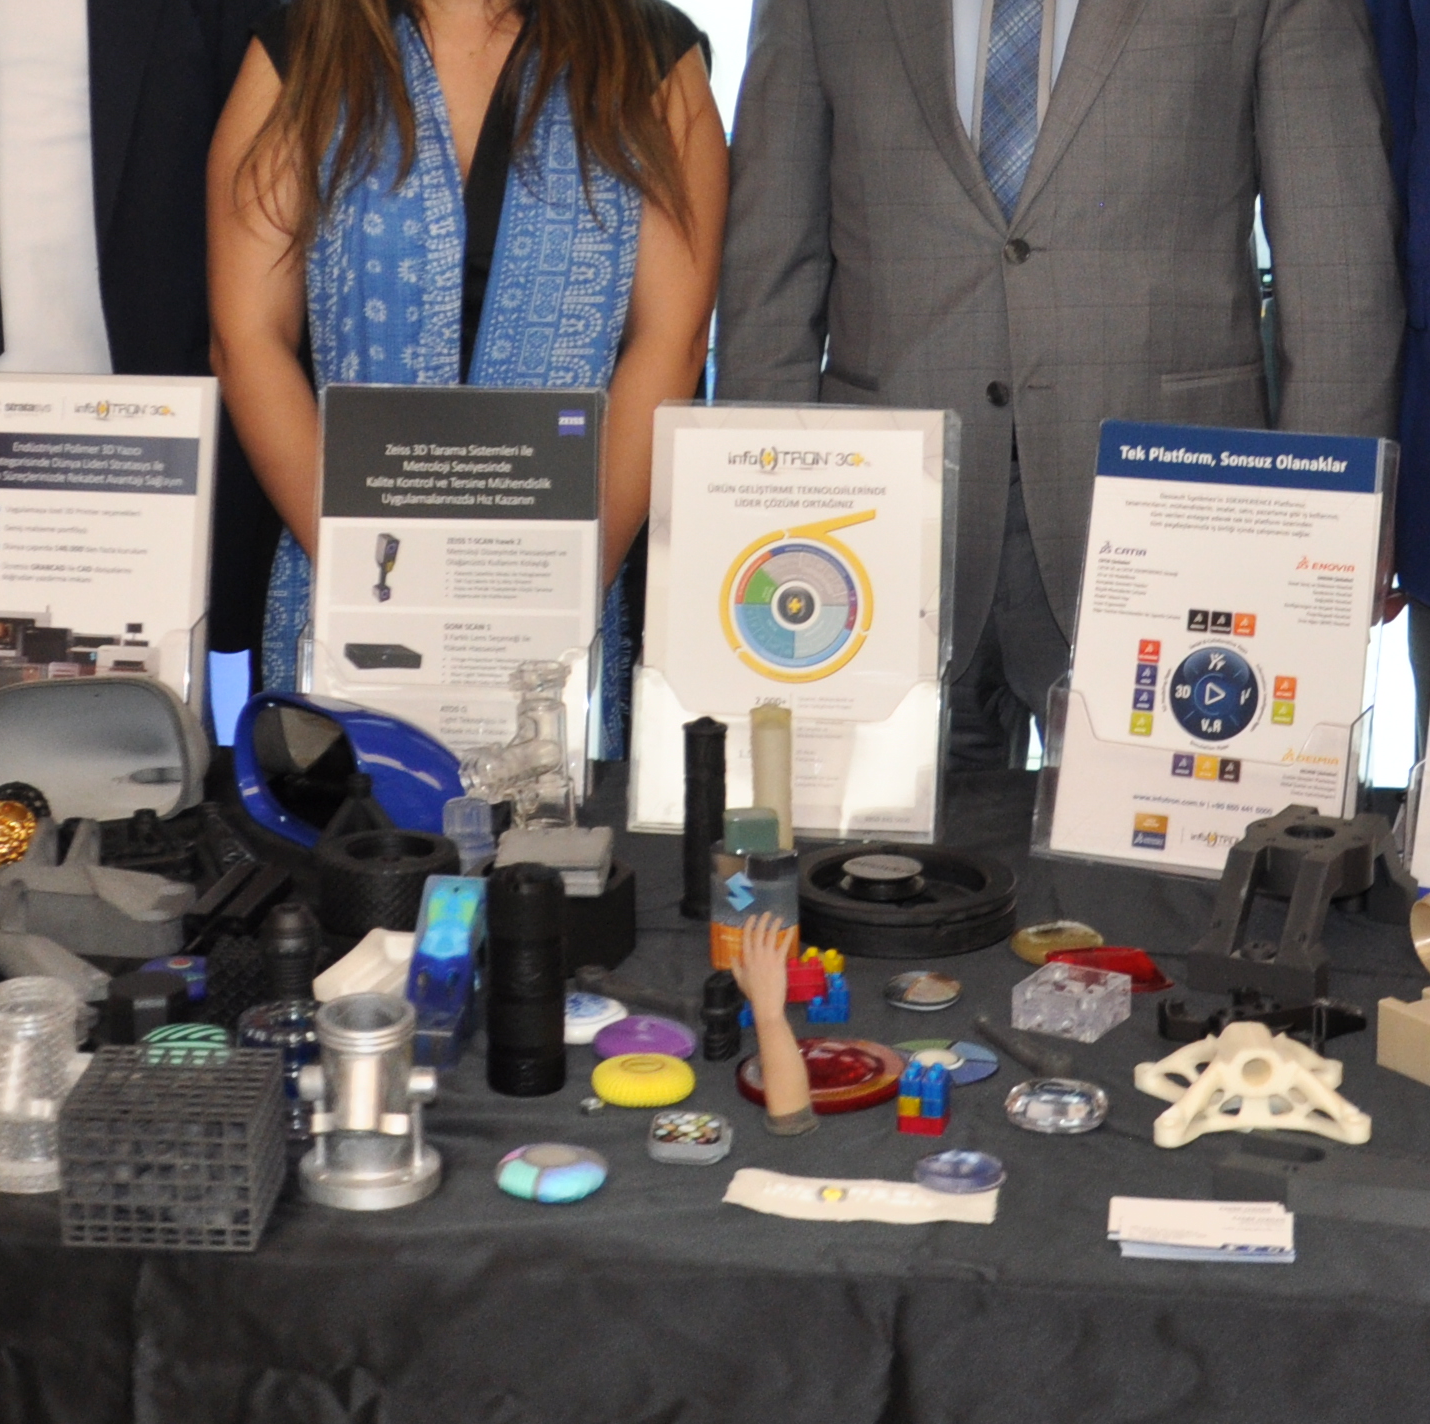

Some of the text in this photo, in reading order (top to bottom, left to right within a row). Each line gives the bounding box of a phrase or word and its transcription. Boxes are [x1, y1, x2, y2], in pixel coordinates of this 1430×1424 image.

[1119, 444, 1348, 473] Tek Platform, Sonsuz Olanaklar
[1114, 546, 1148, 557] CATIA
[1311, 561, 1356, 573] ENOVIA
